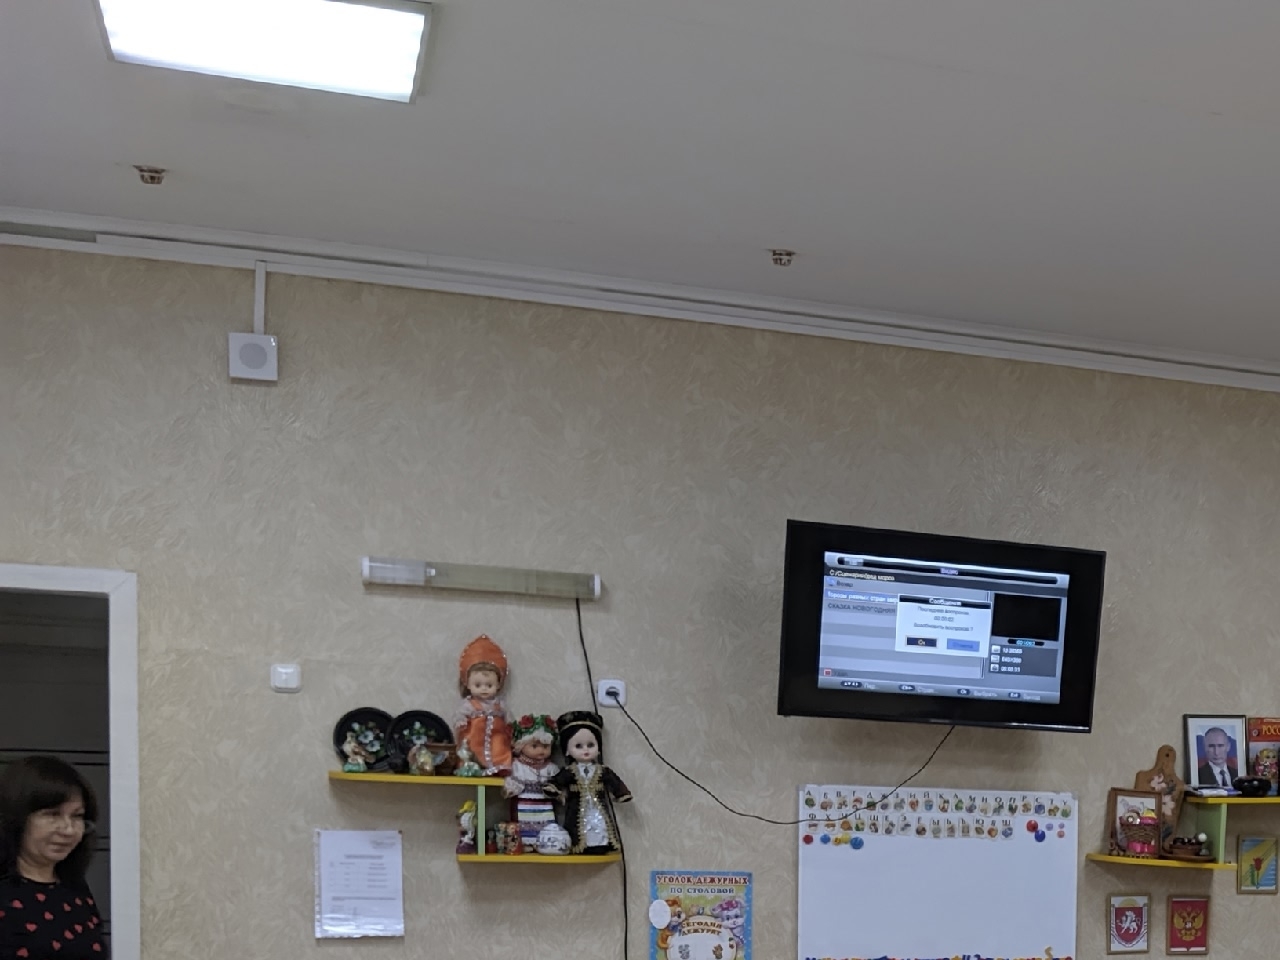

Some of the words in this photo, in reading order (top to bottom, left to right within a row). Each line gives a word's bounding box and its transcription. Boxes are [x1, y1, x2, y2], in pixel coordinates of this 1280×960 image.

[828, 602, 851, 611] СКАЗКА
[656, 875, 692, 884] УГОЛОК
[695, 876, 749, 885] ДЕЖУРНЫХ
[682, 921, 722, 929] СЕГОДНЯ
[681, 928, 722, 937] ДЕЖУРЯТ
